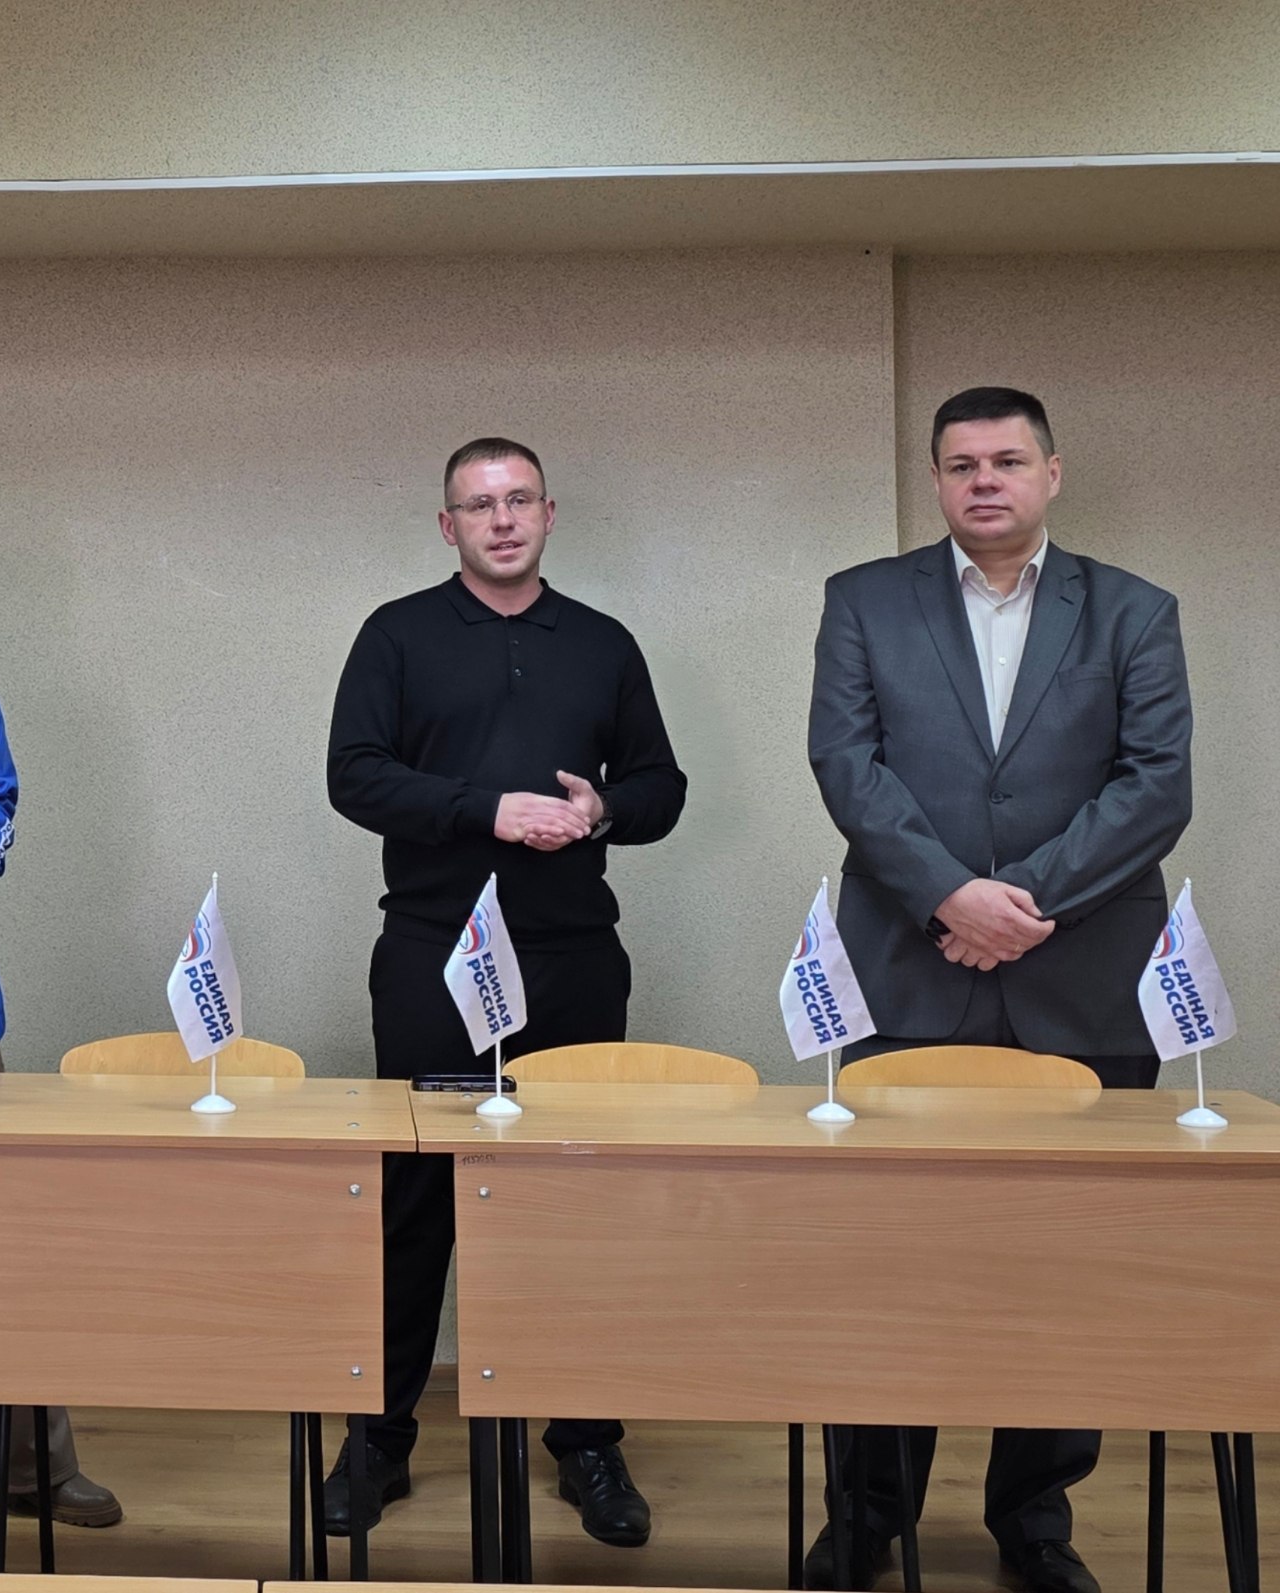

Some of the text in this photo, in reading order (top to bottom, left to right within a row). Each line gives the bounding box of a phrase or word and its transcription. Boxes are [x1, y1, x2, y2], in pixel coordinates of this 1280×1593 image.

[184, 966, 224, 1044] РОССИЯ
[199, 959, 235, 1037] ЕДИНАЯ
[466, 958, 501, 1036] РОССИЯ
[481, 951, 513, 1028] ЕДИНАЯ
[793, 963, 833, 1045] РОССИЯ
[807, 959, 848, 1039] ЕДИНАЯ
[1155, 963, 1198, 1045] РОССИЯ
[1170, 958, 1215, 1039] ЕДИНАЯ
